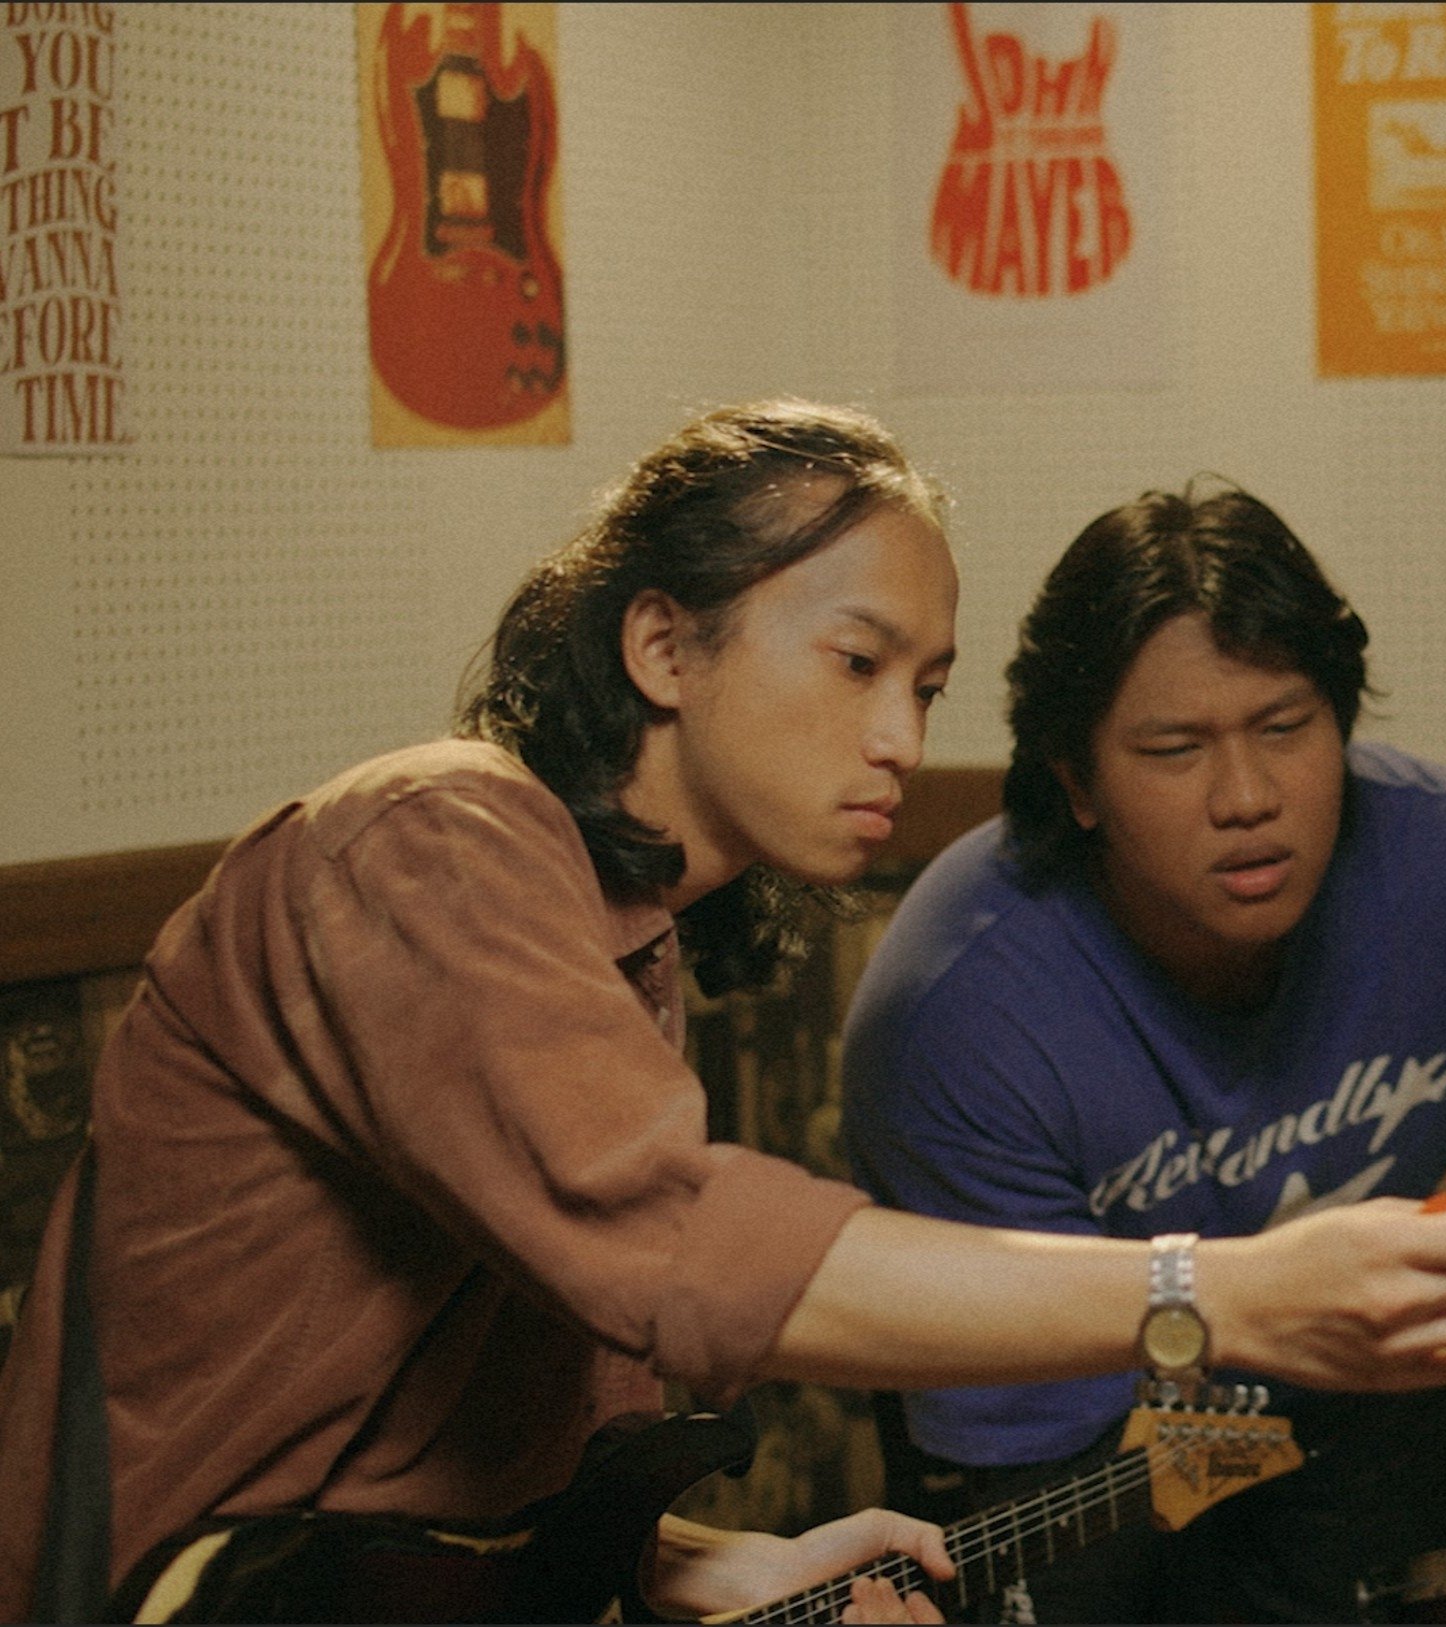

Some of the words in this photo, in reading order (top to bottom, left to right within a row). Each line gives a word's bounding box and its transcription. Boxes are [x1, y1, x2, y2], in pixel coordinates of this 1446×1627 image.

[15, 30, 116, 99] YOU
[1336, 28, 1398, 84] To
[48, 98, 117, 172] BE
[928, 157, 1133, 297] MAYER
